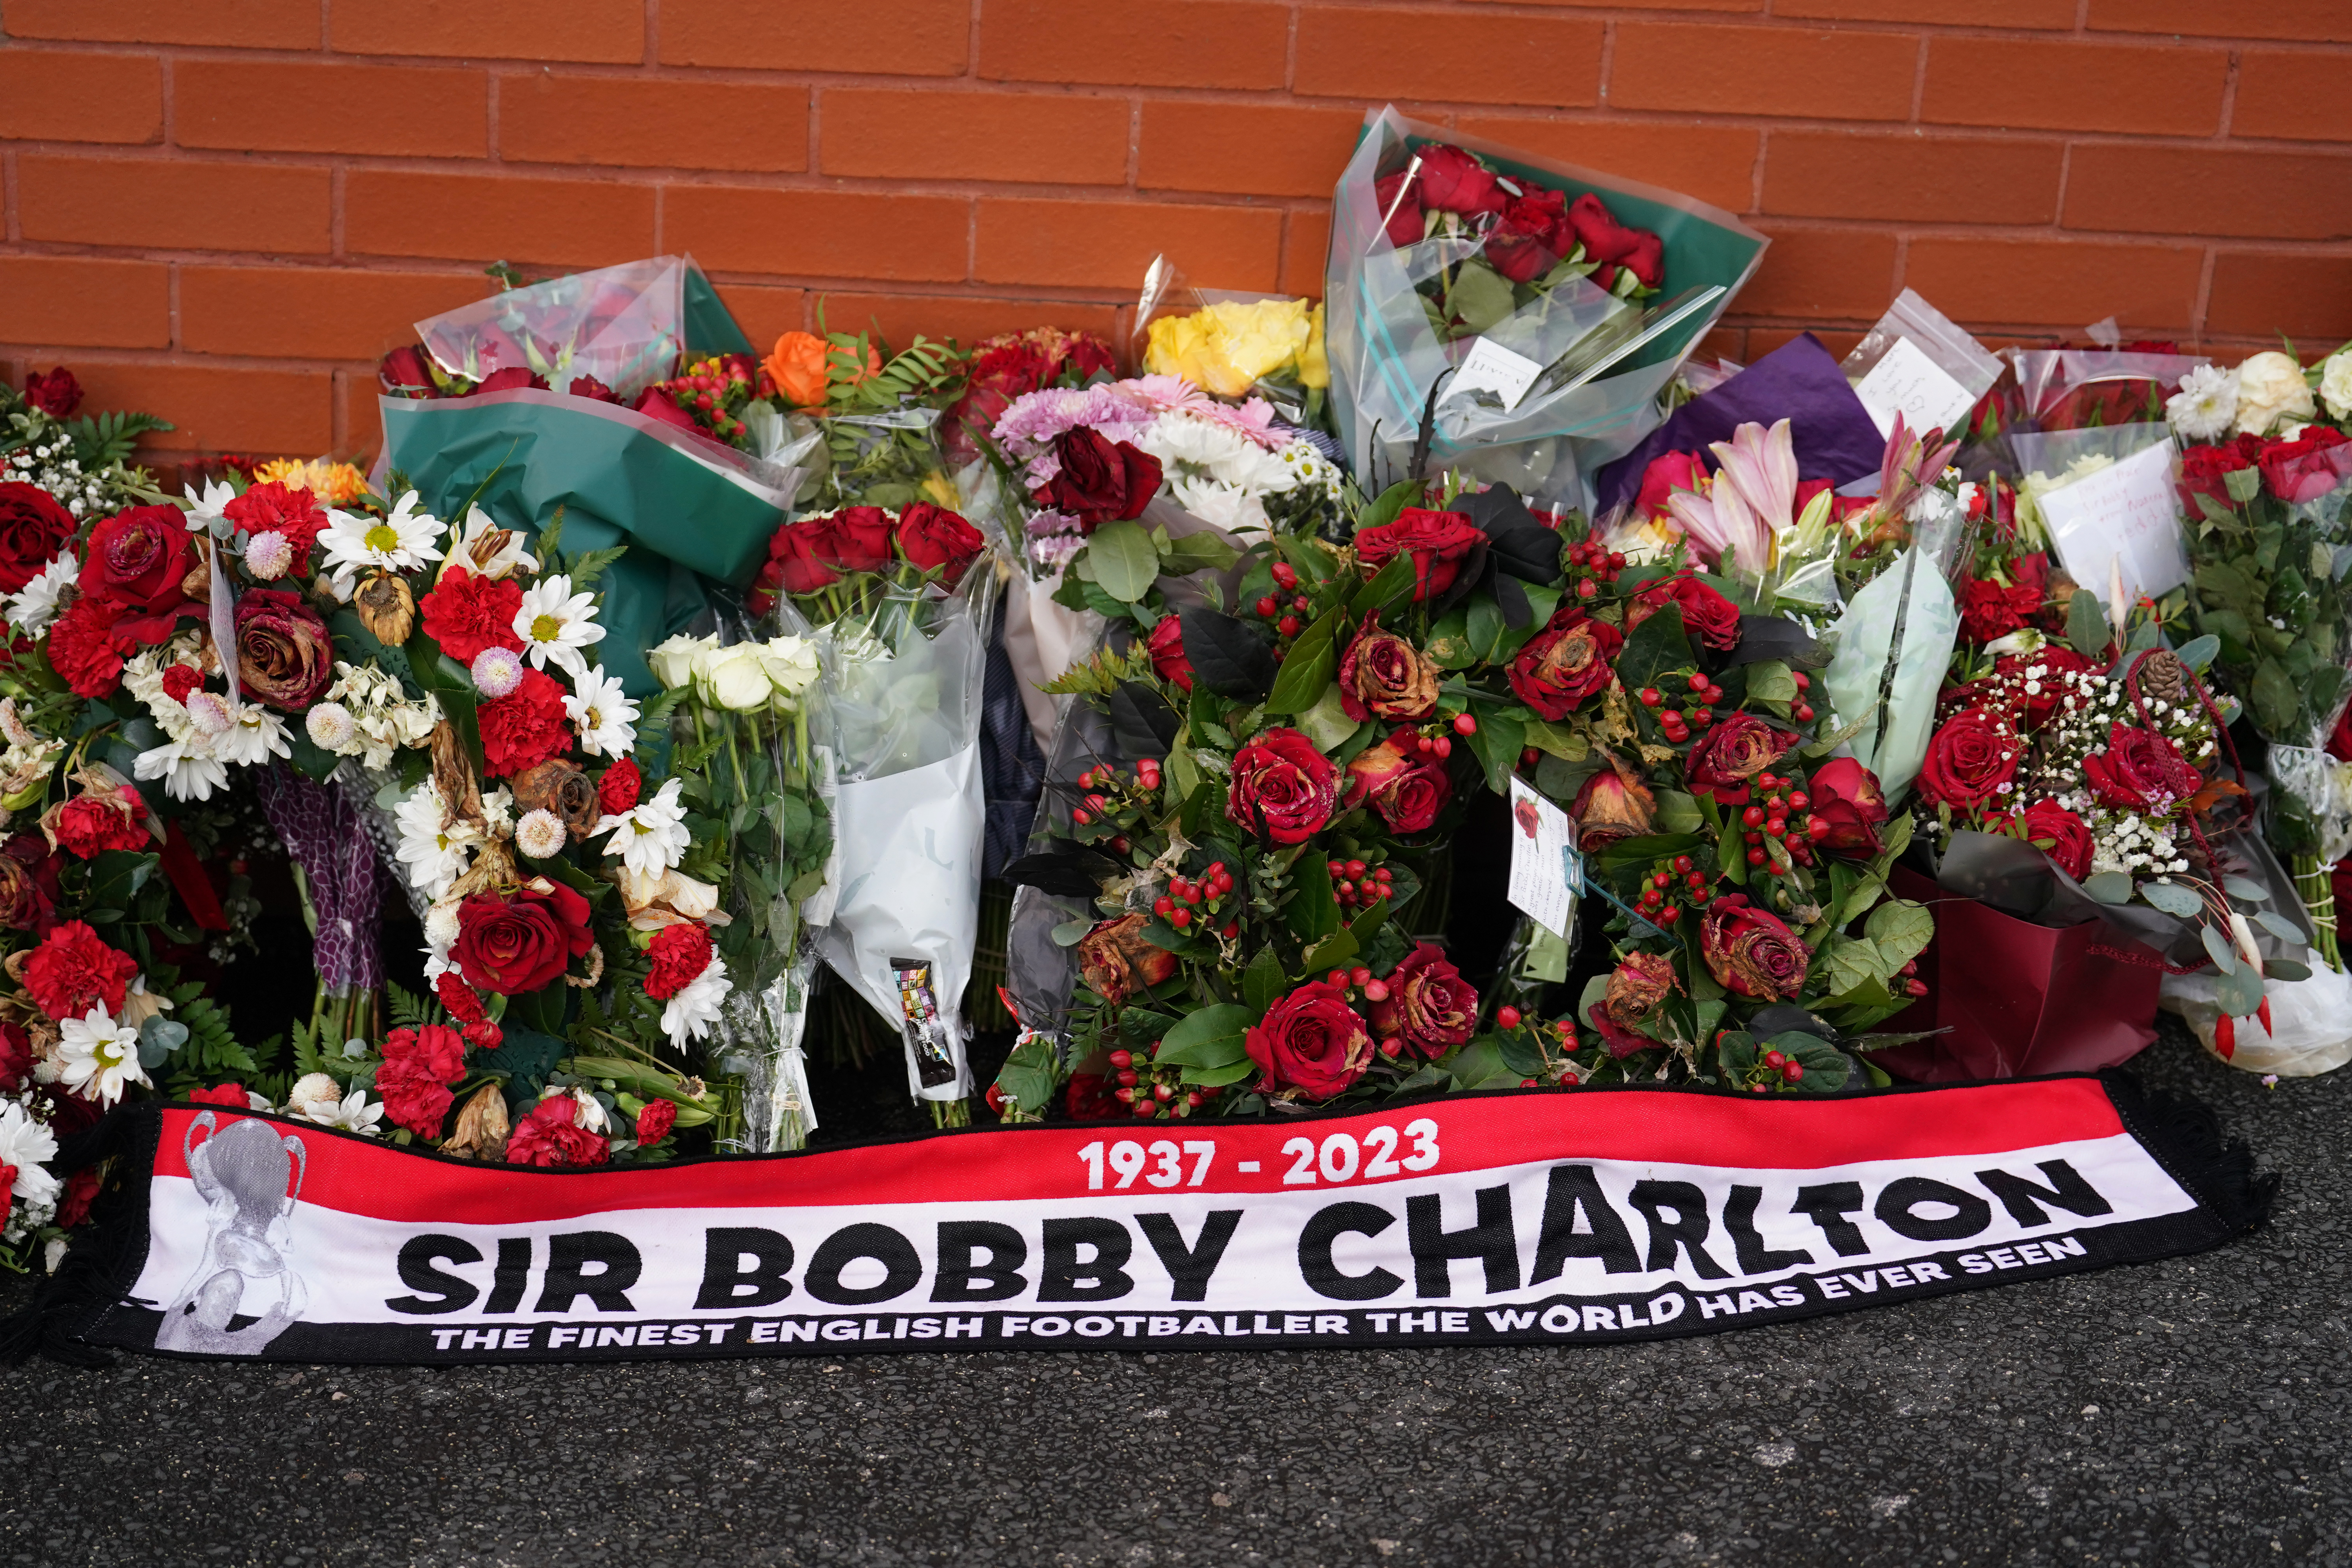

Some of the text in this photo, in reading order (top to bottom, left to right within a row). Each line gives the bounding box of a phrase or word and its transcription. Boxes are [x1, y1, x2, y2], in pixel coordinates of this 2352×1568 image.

[1513, 871, 1525, 890] loving
[916, 1018, 925, 1041] FLOWER
[922, 1041, 930, 1056] FOOD
[1077, 1118, 1440, 1190] 1937 - 2023
[385, 1159, 2113, 1315] SIR BOBBY CHARLTON
[431, 1237, 2087, 1350] THE FINEST ENGLISH FOOTBALLER THE WORLD HAS EVER SEEN
